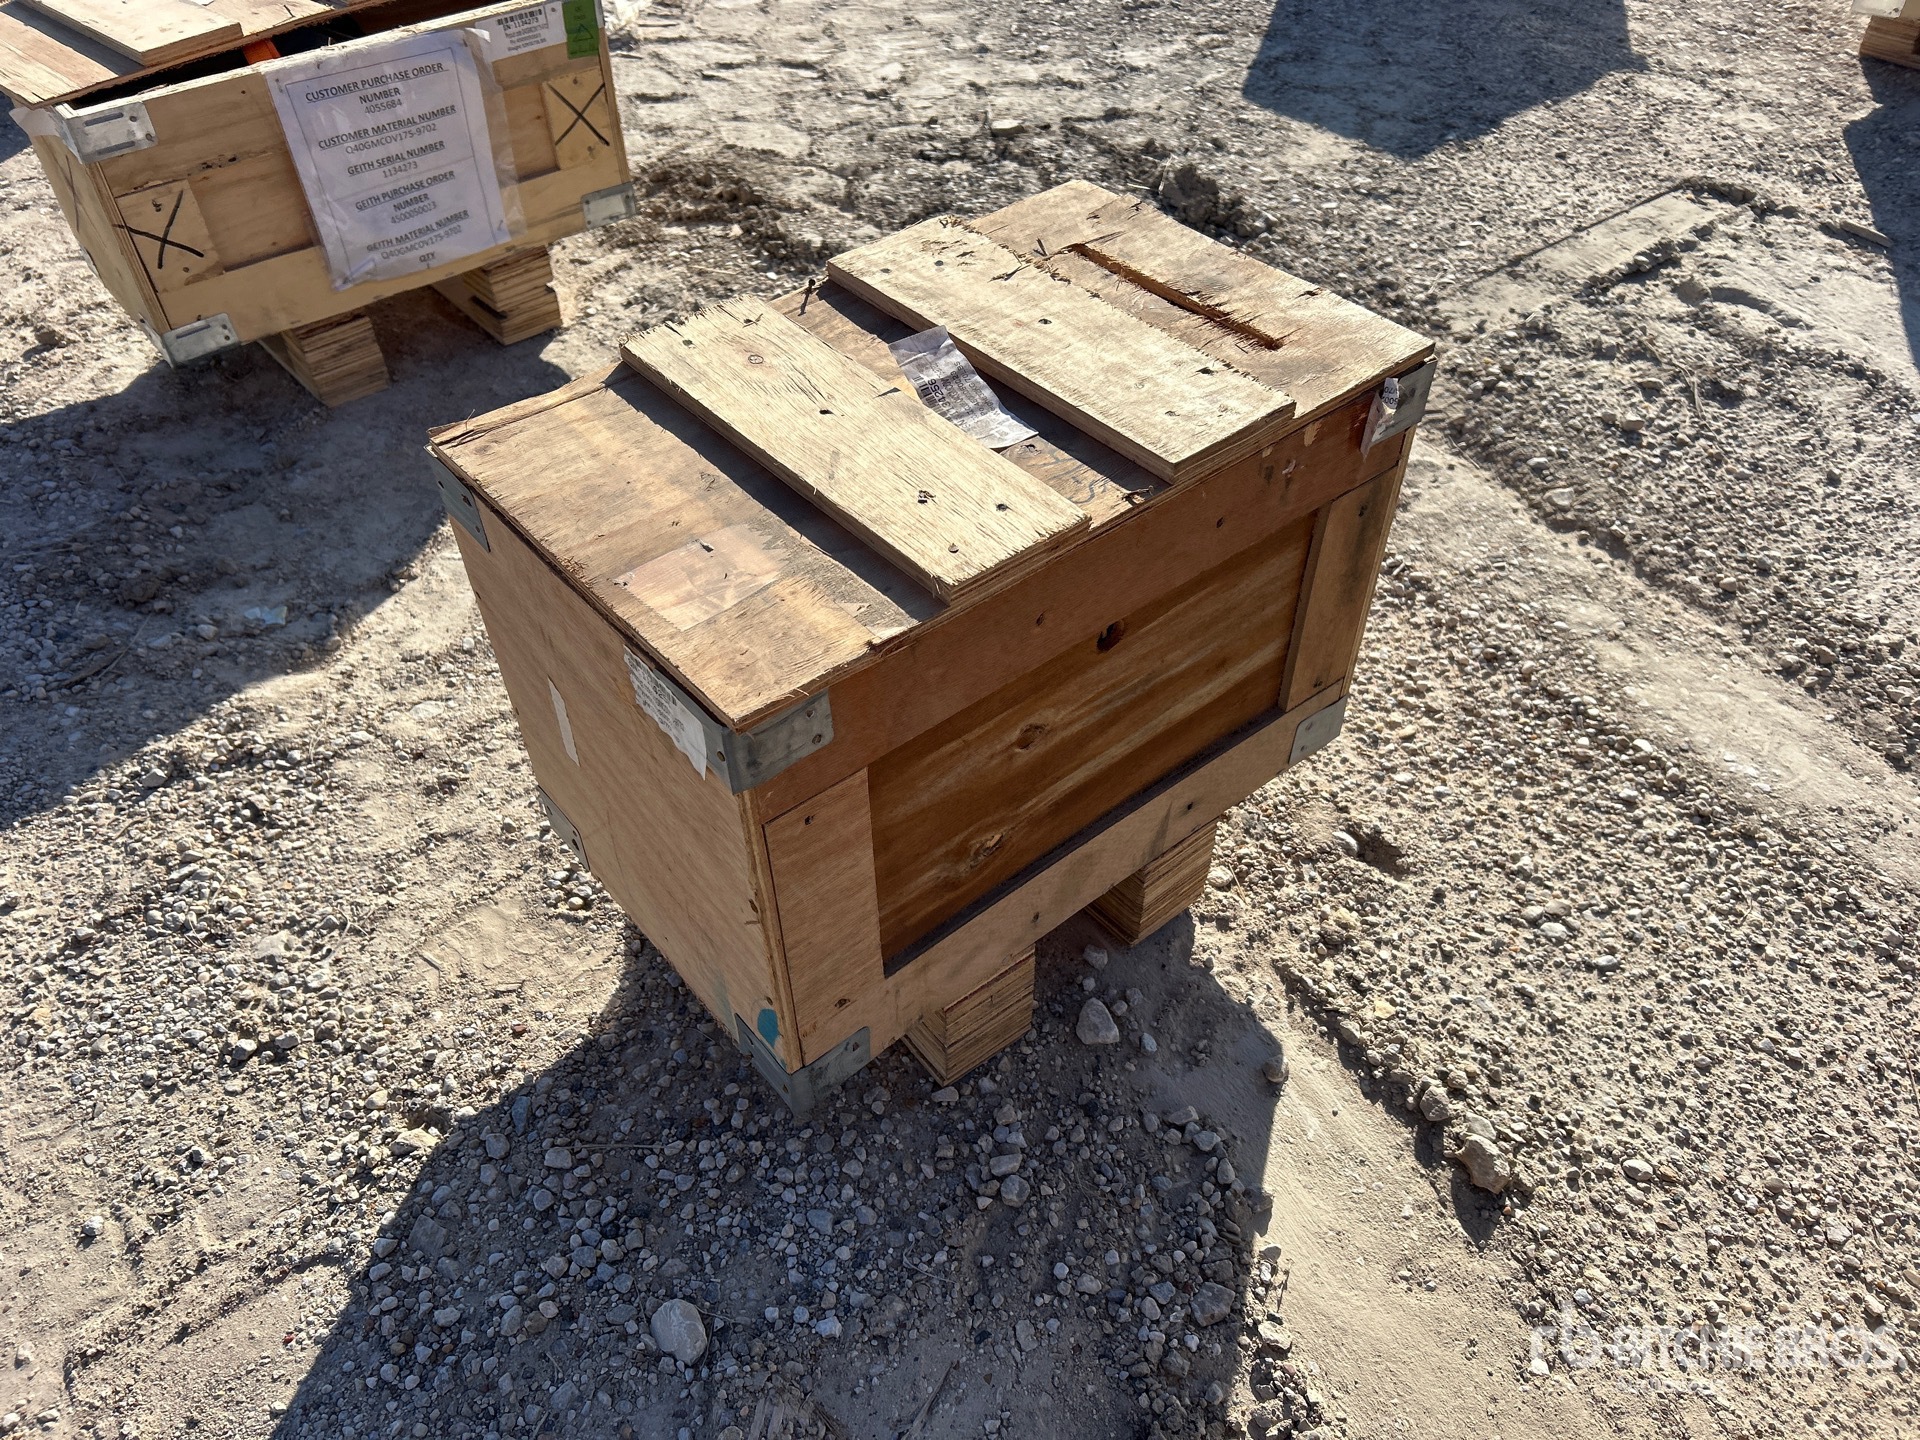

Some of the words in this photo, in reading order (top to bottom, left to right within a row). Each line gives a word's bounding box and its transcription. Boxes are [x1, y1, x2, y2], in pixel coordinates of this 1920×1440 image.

[305, 81, 360, 102] CUSTOMER
[360, 70, 410, 90] PURCHASE
[411, 62, 444, 77] ORDER
[359, 87, 401, 105] NUMBER
[364, 98, 403, 115] 4055684
[318, 127, 370, 150] CUSTOMER
[371, 116, 417, 136] MATERIAL
[417, 104, 457, 121] NUMBER
[347, 160, 375, 176] GEITH
[375, 152, 405, 168] SERIAL
[406, 140, 446, 158] NUMBER
[382, 161, 418, 178] 1134273
[355, 195, 381, 212] GEITH
[381, 180, 425, 200] PURCHASE
[425, 170, 455, 186] ORDER
[393, 193, 430, 212] NUMBER
[366, 239, 393, 252] GEITH
[394, 224, 435, 243] MATERIAL
[435, 209, 470, 228] NUMBER
[419, 251, 436, 263] QTY
[927, 378, 958, 417] 1134256
